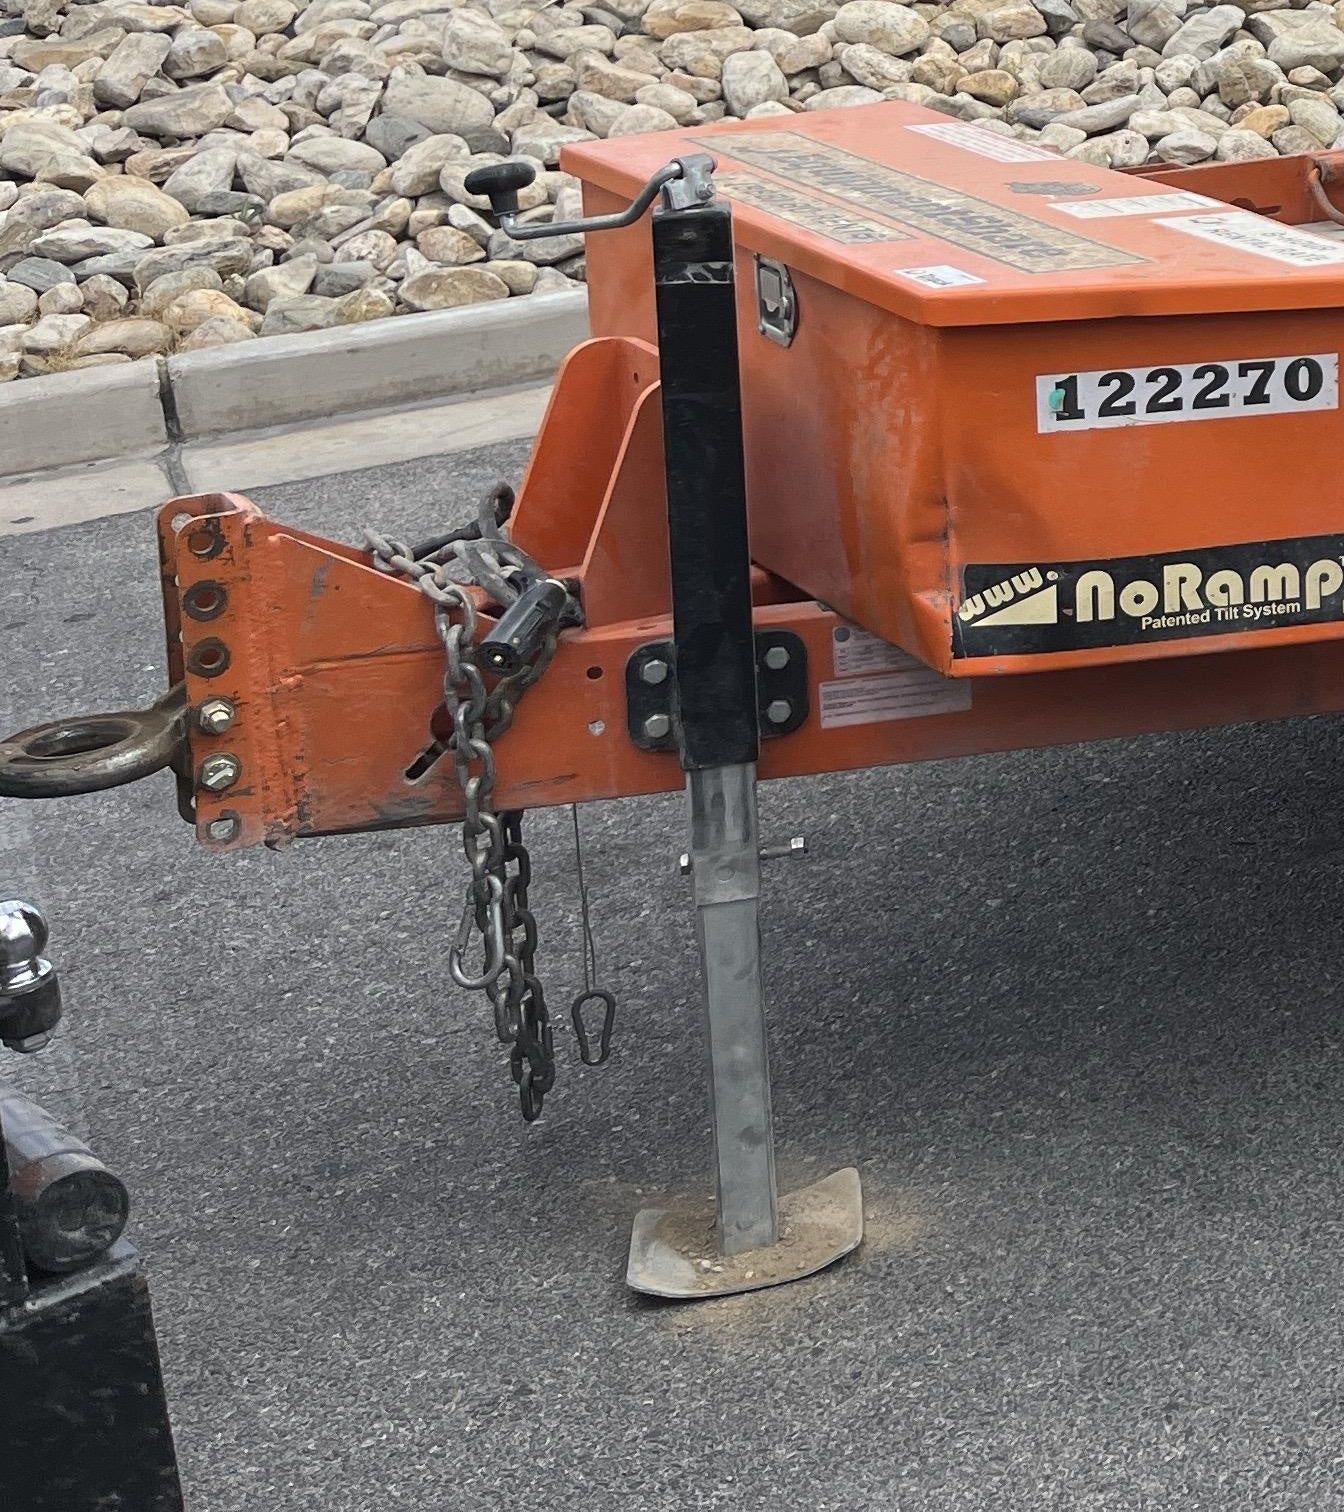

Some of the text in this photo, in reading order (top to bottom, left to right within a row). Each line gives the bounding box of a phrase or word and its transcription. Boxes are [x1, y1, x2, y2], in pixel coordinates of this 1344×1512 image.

[1054, 357, 1324, 421] 122270
[1142, 600, 1301, 630] Patented Tilt System
